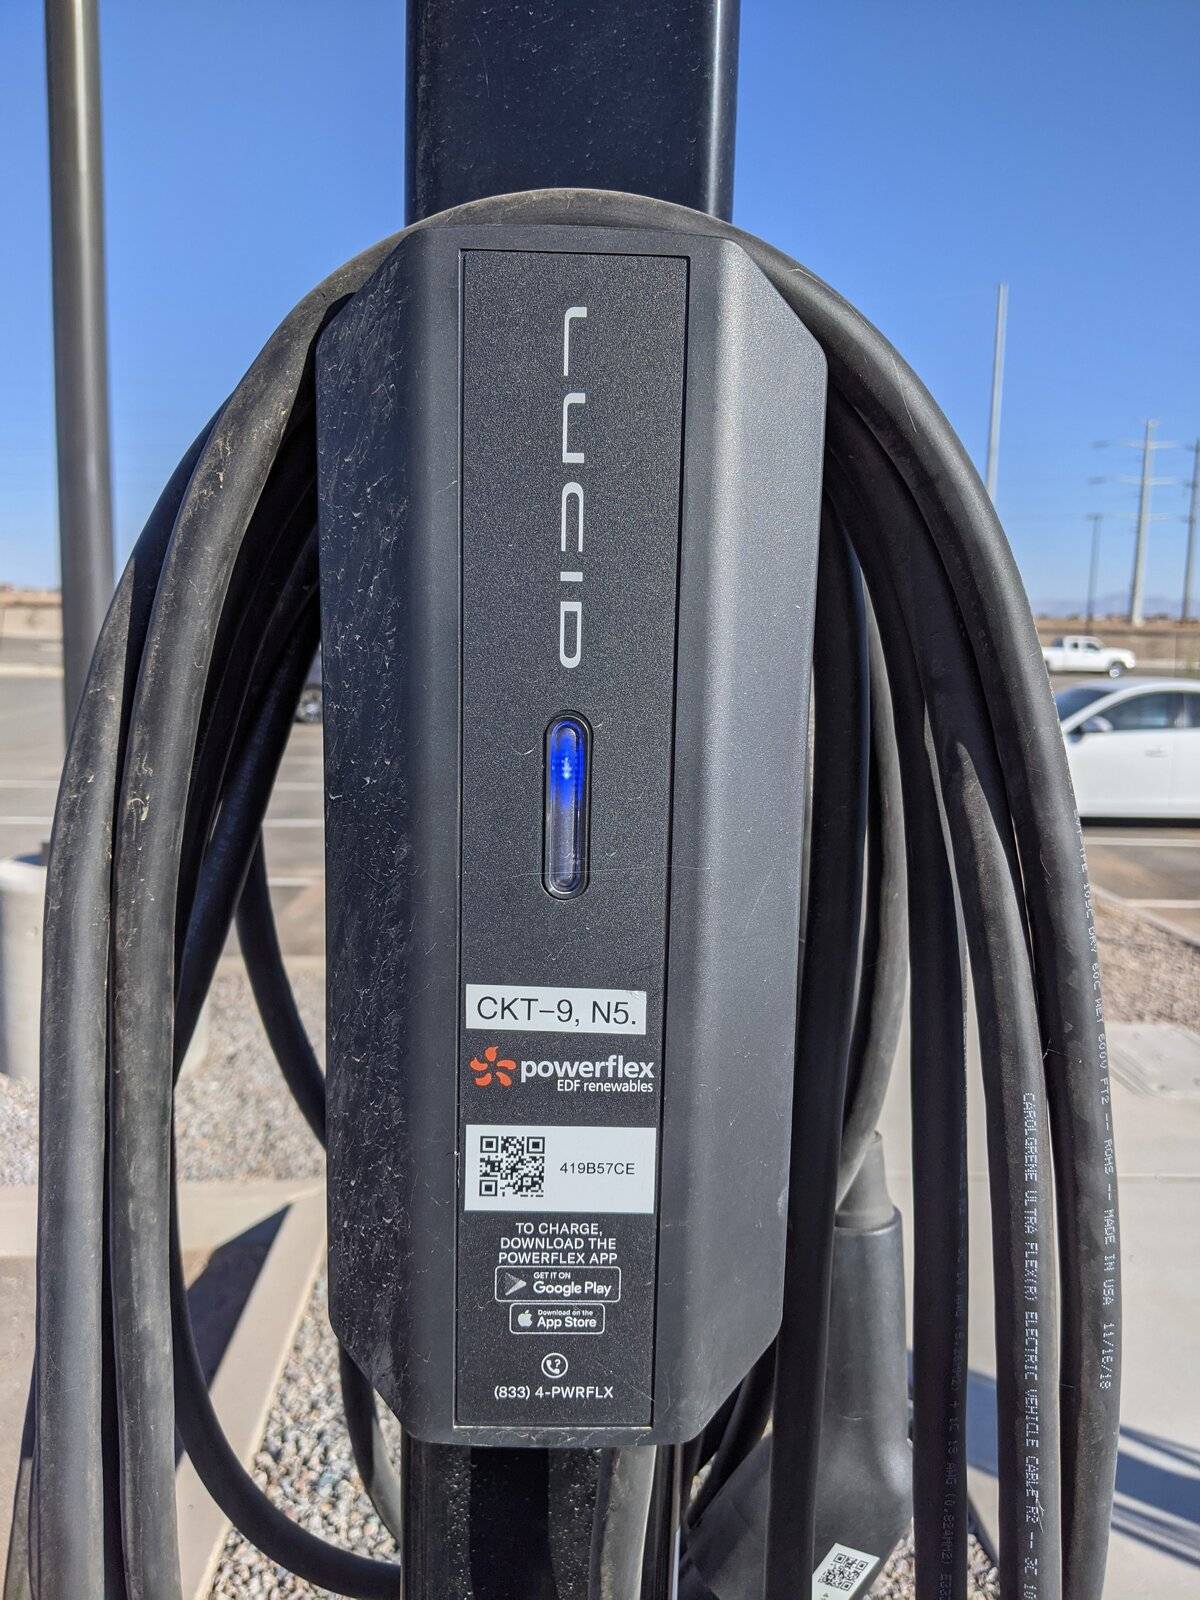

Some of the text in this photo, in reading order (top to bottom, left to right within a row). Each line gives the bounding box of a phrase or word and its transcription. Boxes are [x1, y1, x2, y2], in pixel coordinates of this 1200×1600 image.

[560, 306, 588, 669] LUCID
[477, 996, 637, 1026] CKT-9, N5.
[520, 1054, 654, 1083] powerflex
[557, 1079, 653, 1093] EDF renewables
[1100, 1077, 1110, 1105] FT2
[559, 1162, 635, 1175] 419B57CE
[1024, 1190, 1038, 1234] ULTRA
[516, 1222, 603, 1236] TO CHARGE,
[1103, 1208, 1115, 1245] MADE
[500, 1237, 616, 1250] DOWNLOAD THE
[499, 1252, 618, 1264] POWERFLEX APP
[1024, 1242, 1038, 1301] FLEX(R)
[1104, 1253, 1116, 1271] IN
[533, 1281, 612, 1297] Google Play
[1102, 1279, 1115, 1306] USA
[537, 1316, 597, 1330] App Store
[1024, 1311, 1039, 1381] ELECTRIC
[494, 1386, 614, 1400] (833) 4-PWRFLX
[1024, 1389, 1039, 1448] VEHICLE
[1025, 1455, 1039, 1498] CABLE
